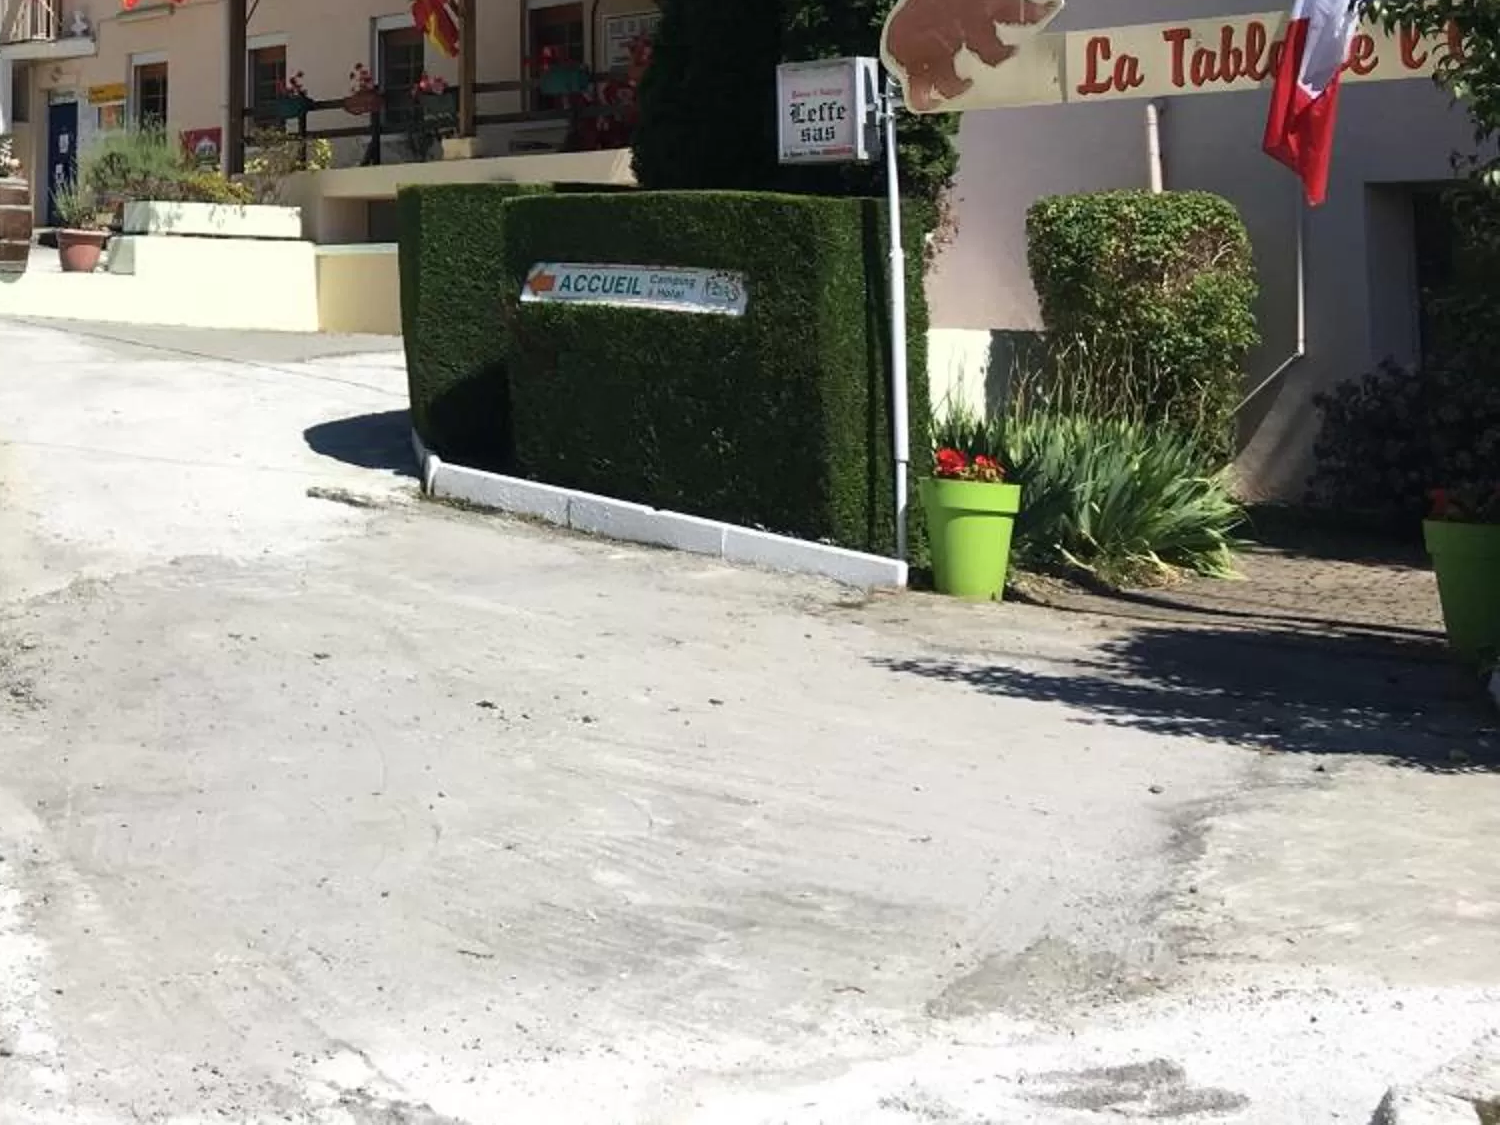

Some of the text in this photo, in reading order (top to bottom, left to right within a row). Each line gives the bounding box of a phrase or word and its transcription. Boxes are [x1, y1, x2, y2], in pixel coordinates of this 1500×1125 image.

[1077, 35, 1144, 96] La
[789, 101, 846, 124] Leffe
[558, 274, 642, 296] ACCUEIL
